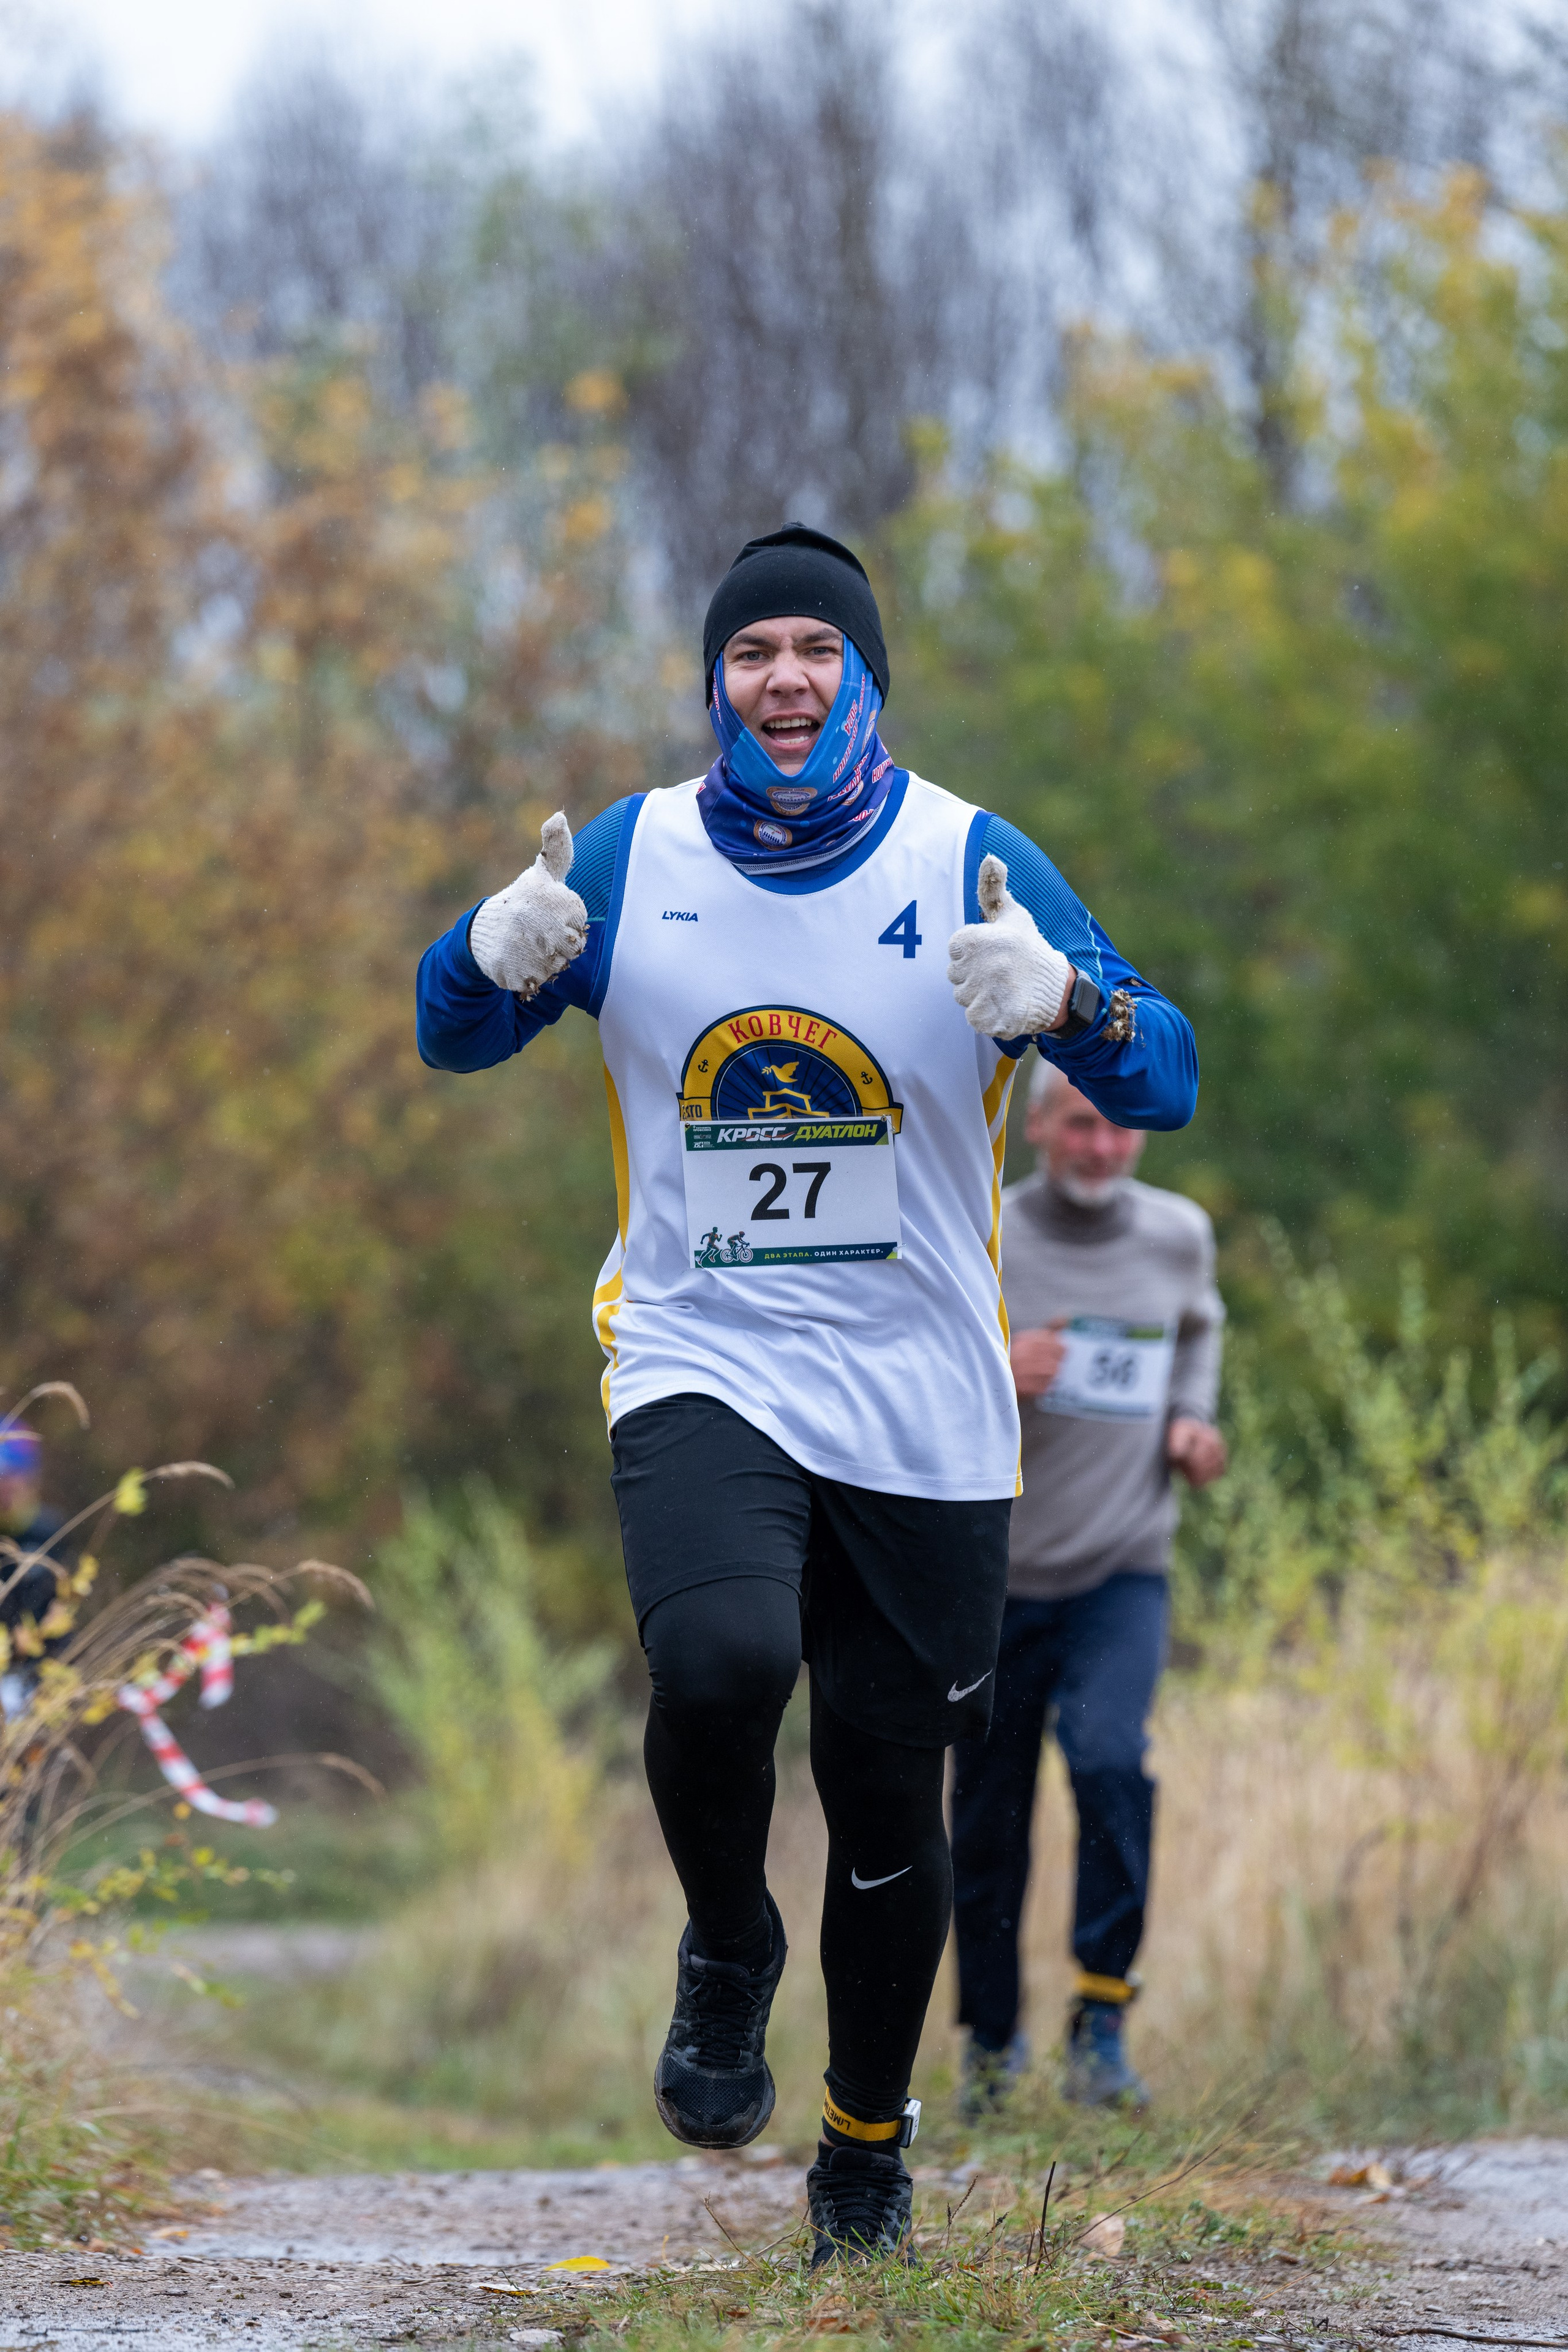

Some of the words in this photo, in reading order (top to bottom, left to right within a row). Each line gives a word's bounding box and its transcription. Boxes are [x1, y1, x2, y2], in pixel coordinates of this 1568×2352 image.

[844, 699, 858, 736] 2024
[662, 910, 698, 922] LYKIA
[878, 900, 922, 959] 4
[728, 1014, 837, 1049] КОВЧЕГ
[717, 1126, 790, 1144] КРОСС
[793, 1123, 877, 1140] ДУАТЛОН
[748, 1161, 831, 1221] 27
